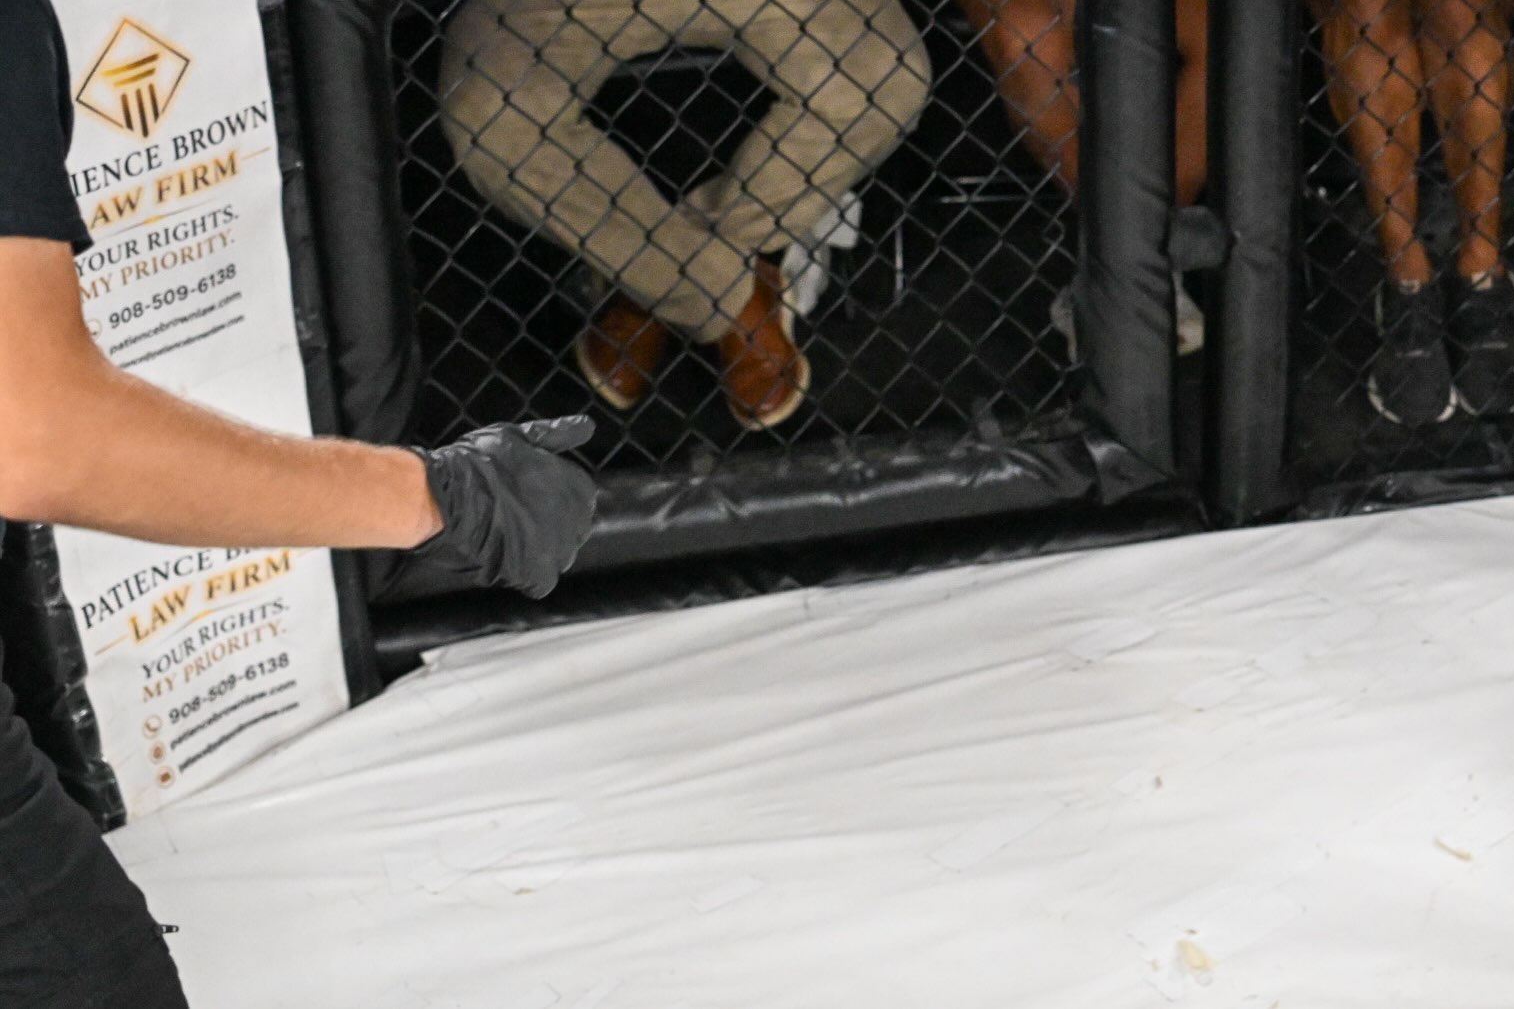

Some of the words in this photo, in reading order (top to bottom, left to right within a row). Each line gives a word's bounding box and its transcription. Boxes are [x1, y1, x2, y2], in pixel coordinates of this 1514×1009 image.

[172, 100, 270, 161] BROWN
[154, 149, 238, 204] FIRM
[74, 239, 140, 277] YOUR
[147, 204, 239, 251] RIGHTS.
[120, 228, 235, 286] PRIORITY.
[108, 263, 237, 330] 908-509-6138
[80, 548, 214, 631] PATIENCE
[127, 584, 194, 643] LAW
[204, 548, 292, 602] FIRM
[140, 637, 198, 680] YOUR
[199, 596, 290, 648] RIGHTS.
[142, 672, 177, 702] MY
[183, 619, 288, 683] PRIORITY.
[168, 652, 290, 724] 908-509-6138
